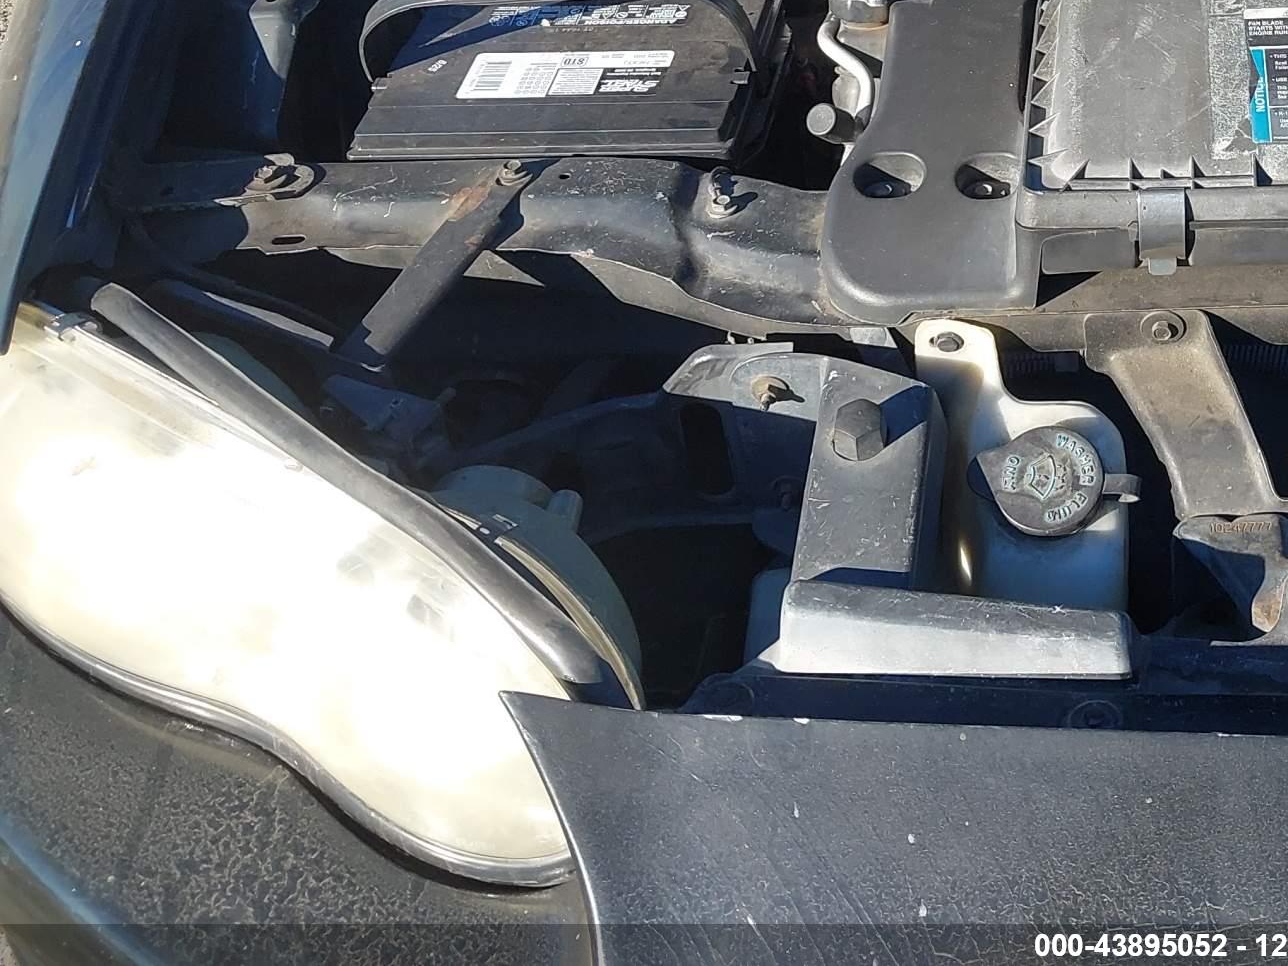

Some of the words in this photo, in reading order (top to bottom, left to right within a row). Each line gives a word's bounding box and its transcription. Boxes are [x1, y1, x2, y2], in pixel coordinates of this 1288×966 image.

[1056, 433, 1096, 486] WASHER
[1044, 491, 1088, 522] FLUID
[1209, 521, 1273, 533] 10247777
